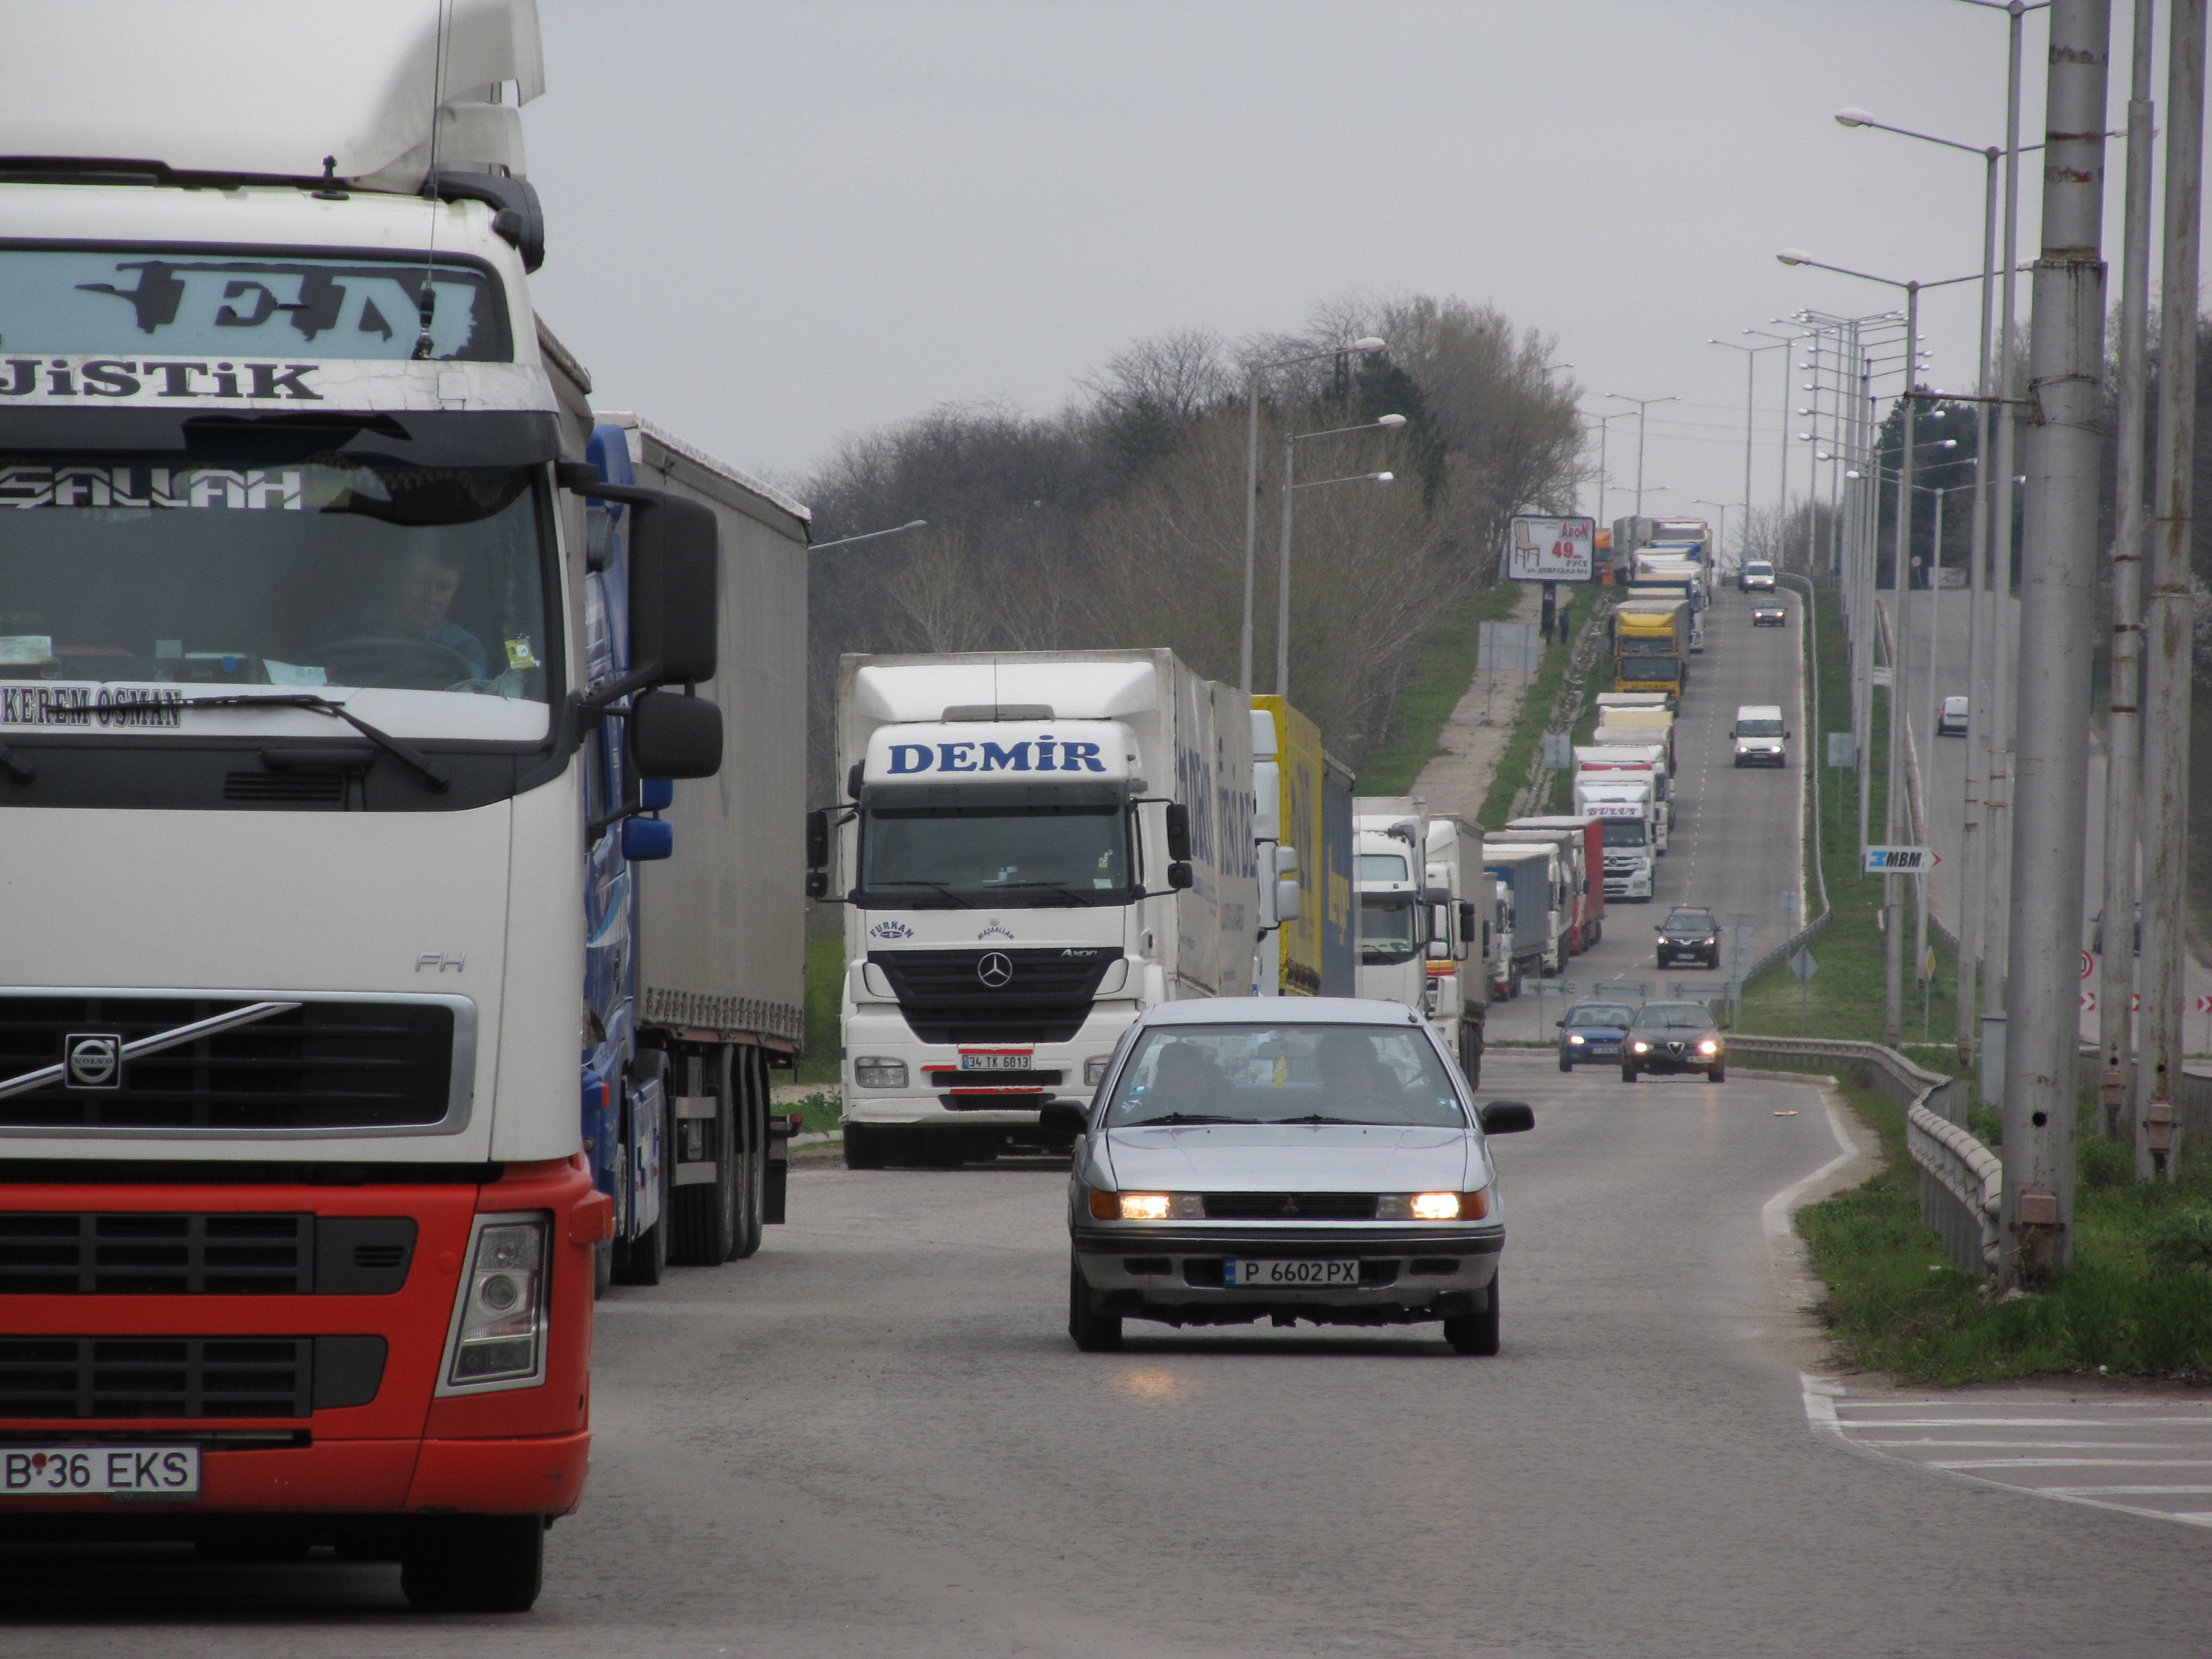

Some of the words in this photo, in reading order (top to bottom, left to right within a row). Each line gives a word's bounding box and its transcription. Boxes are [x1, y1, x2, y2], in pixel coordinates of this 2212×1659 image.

[1, 687, 91, 727] KEREM
[95, 687, 182, 727] OSMAN
[1885, 851, 1923, 868] MBM
[870, 921, 915, 939] FURKAN
[415, 952, 466, 972] FH
[969, 1057, 981, 1068] 34
[987, 1057, 998, 1068] TK
[1003, 1057, 1029, 1068] 6013
[1245, 1263, 1259, 1281] P
[1271, 1263, 1323, 1282] 6602
[1328, 1263, 1355, 1282] PX
[6, 1453, 31, 1489] B
[48, 1453, 91, 1488] 36
[108, 1452, 188, 1488] EKS
